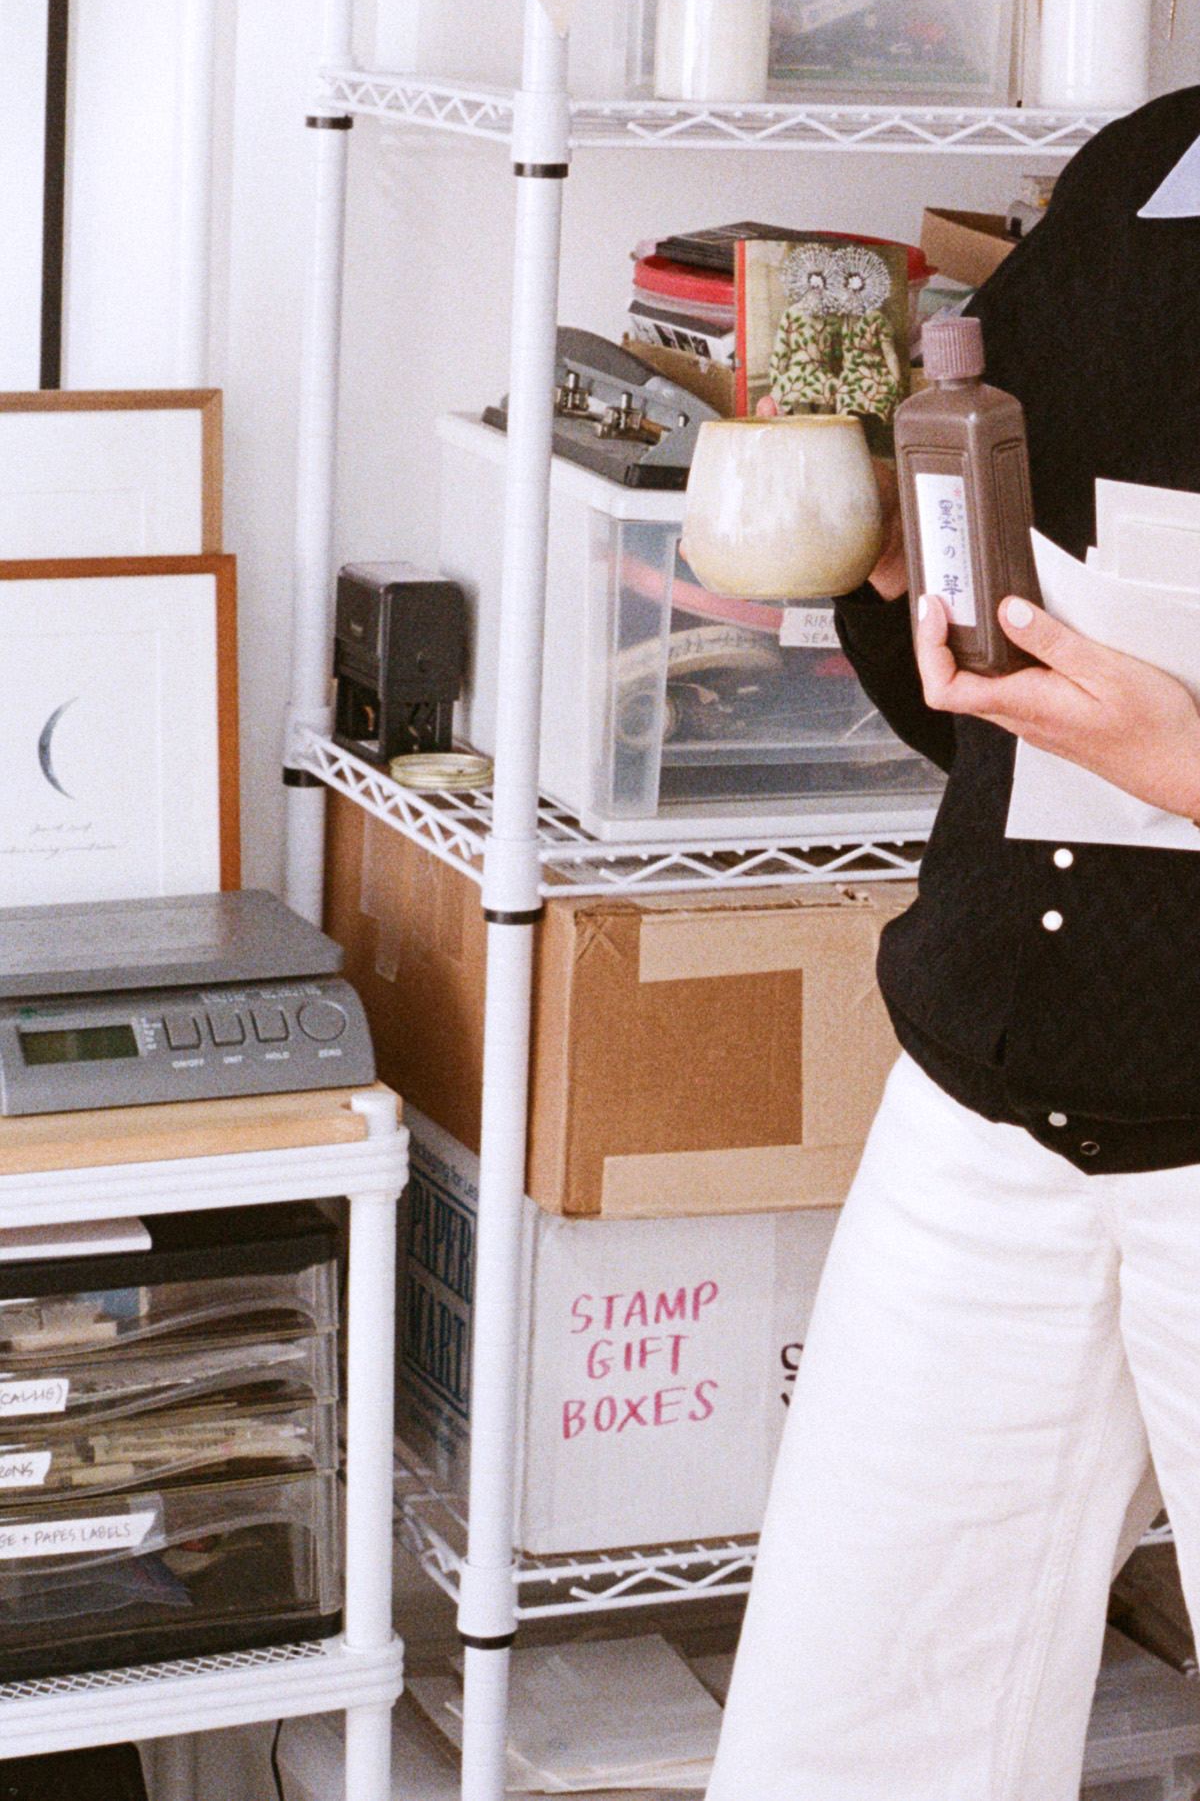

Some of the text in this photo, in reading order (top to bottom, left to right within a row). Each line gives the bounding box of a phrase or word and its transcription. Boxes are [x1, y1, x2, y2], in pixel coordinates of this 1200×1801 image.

[408, 1171, 474, 1305] PAPER
[403, 1269, 467, 1402] MART
[571, 1280, 718, 1334] STAMP
[586, 1334, 690, 1380] GIFT
[562, 1379, 719, 1440] BOXES
[81, 1523, 131, 1542] LABELS
